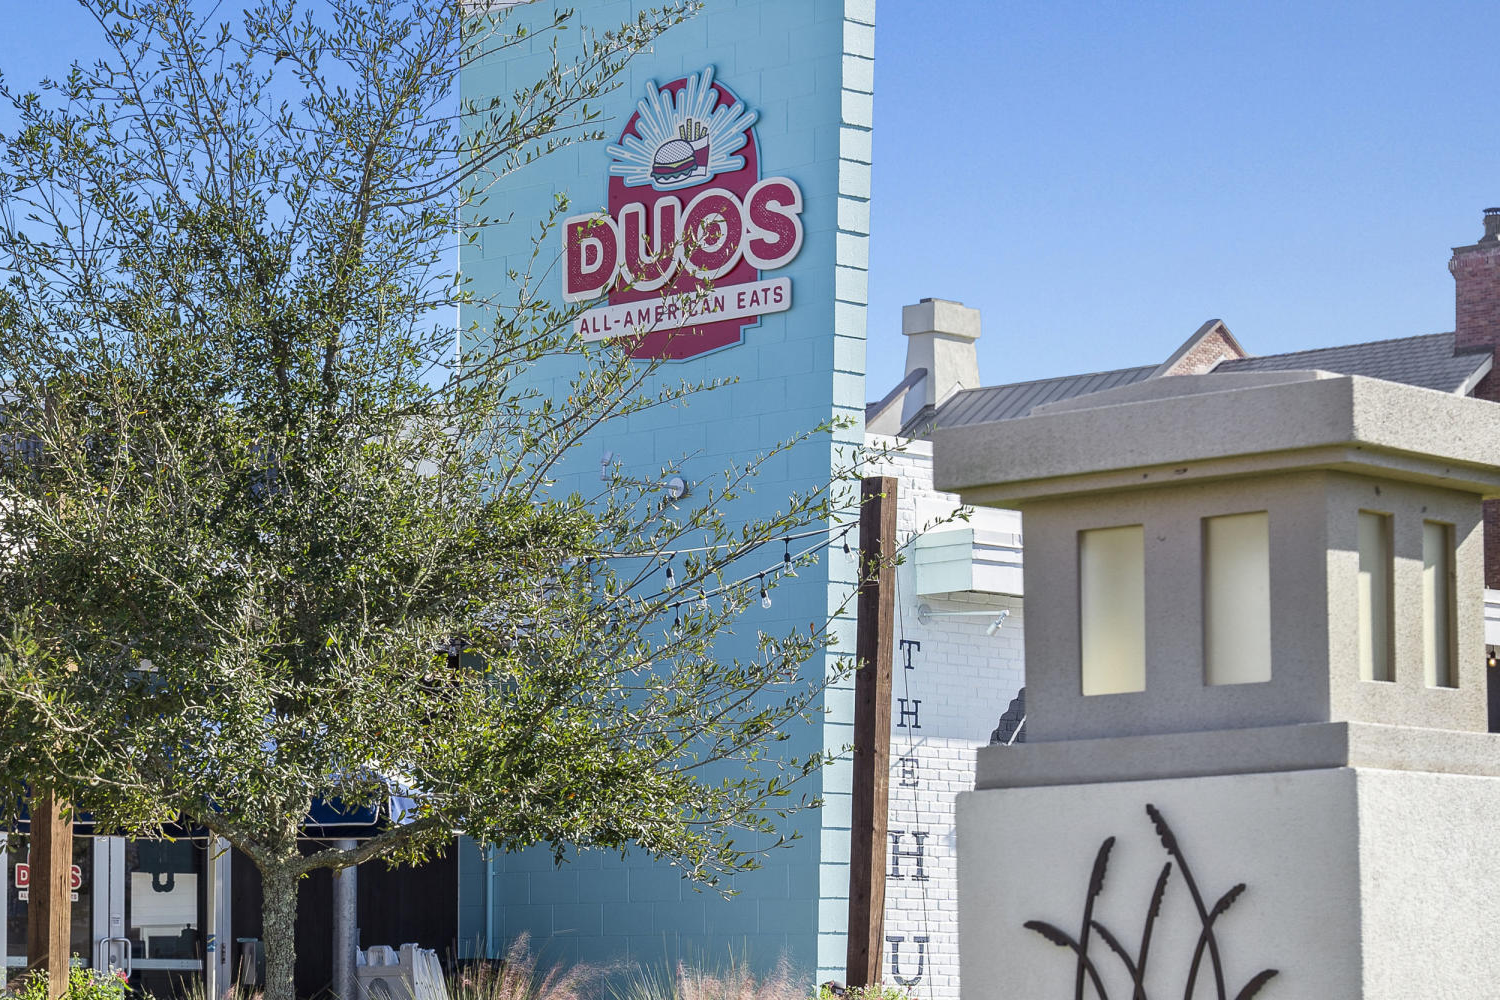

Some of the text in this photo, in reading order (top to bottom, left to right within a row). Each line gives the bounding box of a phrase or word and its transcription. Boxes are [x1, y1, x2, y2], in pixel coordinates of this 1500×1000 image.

[563, 178, 802, 301] DUOS
[737, 285, 784, 309] EATS
[897, 639, 921, 787] THE
[15, 863, 81, 890] DS
